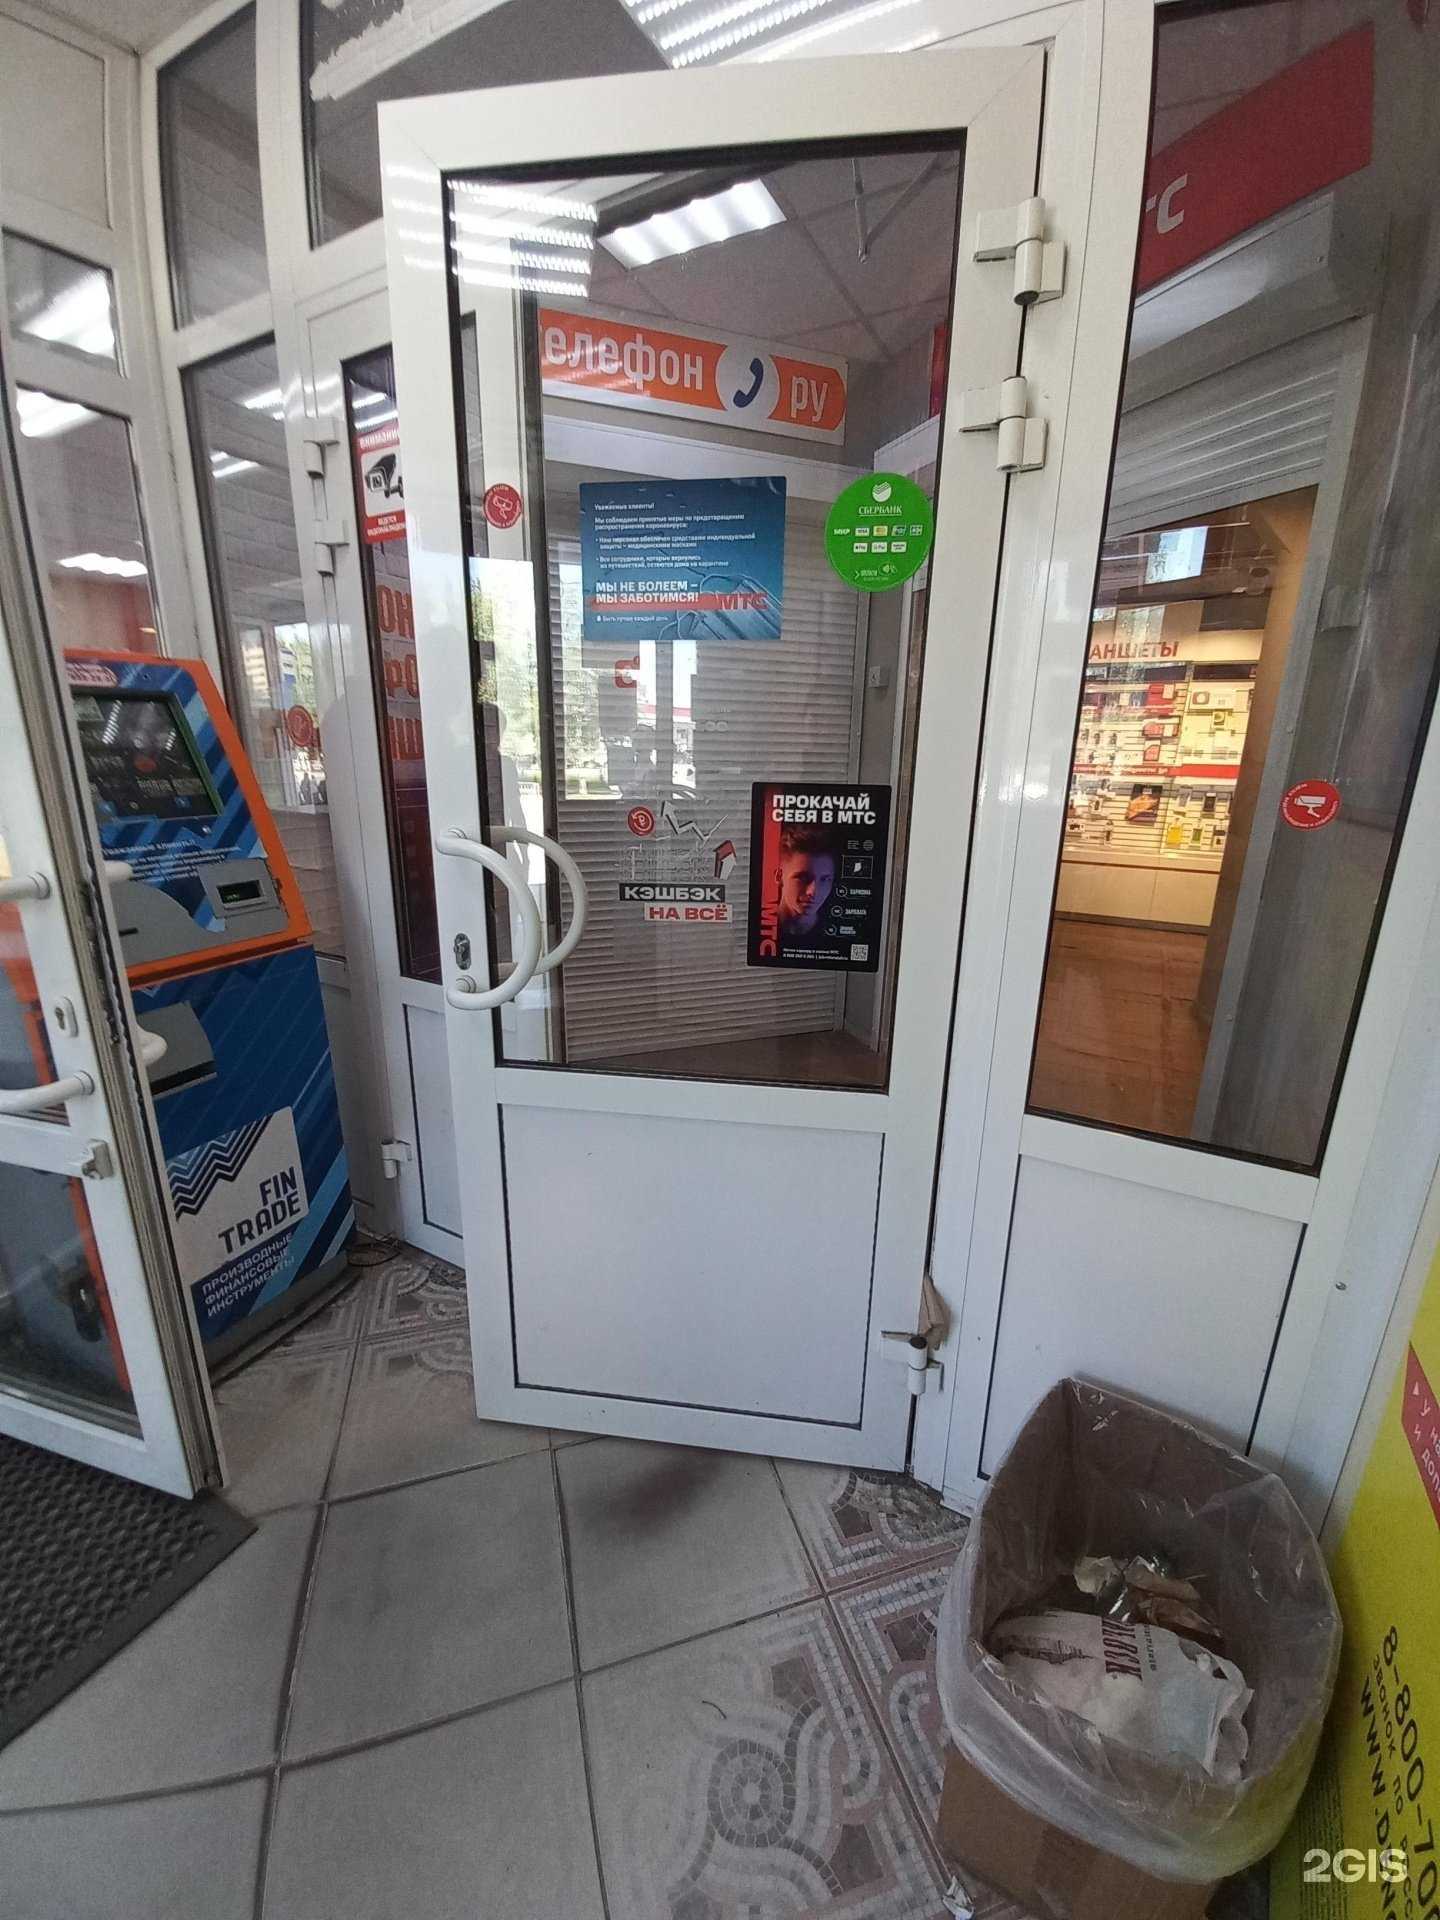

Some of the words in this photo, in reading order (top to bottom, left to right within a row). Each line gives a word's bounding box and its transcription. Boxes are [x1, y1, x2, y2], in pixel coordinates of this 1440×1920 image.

[1146, 172, 1188, 234] С
[538, 325, 703, 391] елефон
[858, 505, 902, 515] СБЕРБАНК
[595, 582, 617, 593] МЫ
[620, 581, 636, 592] НЕ
[638, 580, 687, 592] БОЛЕЕМ
[595, 593, 618, 604] МЫ
[619, 591, 699, 603] ЗАБОТИМСЯ!
[771, 809, 817, 823] СЕБЯ
[821, 810, 833, 824] В
[837, 811, 876, 825] МТС
[772, 792, 870, 810] ПРОКАЧАЙ
[624, 886, 721, 901] КЭШБЭК
[649, 906, 681, 920] НА
[685, 904, 728, 921] ВСЁ
[760, 900, 779, 957] МТС
[259, 1166, 298, 1207] FIN
[218, 1191, 301, 1254] TRADE
[202, 1232, 292, 1296] ПРОИЗВОДНЫЕ
[204, 1247, 289, 1305] ФИНАНСОВЫЕ
[207, 1255, 295, 1317] ИНСТРУМЕНТЫ
